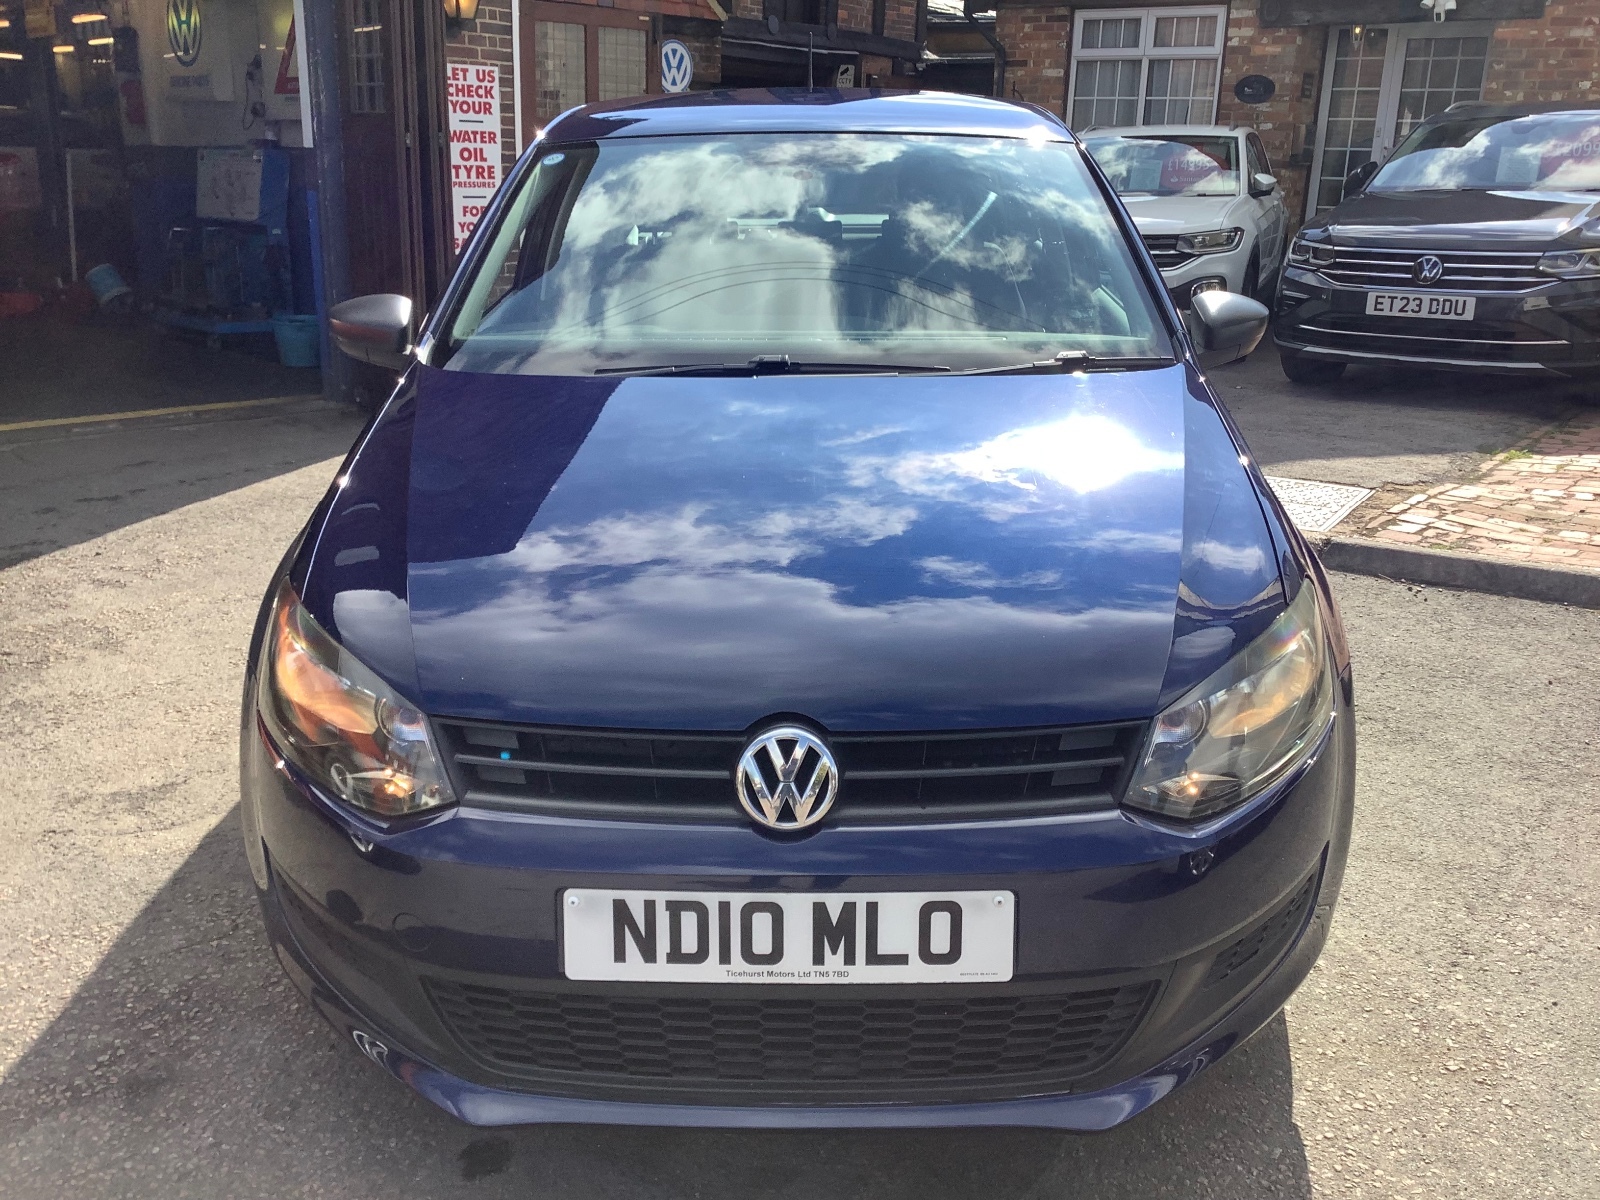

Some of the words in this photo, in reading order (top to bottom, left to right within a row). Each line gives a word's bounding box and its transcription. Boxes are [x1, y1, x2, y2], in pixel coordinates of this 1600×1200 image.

[475, 68, 496, 83] US
[447, 83, 495, 100] CHECK
[448, 99, 493, 115] YOUR
[449, 129, 497, 144] WATER
[459, 147, 488, 163] OIL
[452, 164, 496, 180] TYRE
[452, 180, 496, 188] PRESSURES
[1373, 295, 1423, 314] ET23
[1427, 298, 1467, 317] DDU
[736, 727, 838, 830] VW
[612, 898, 784, 966] ND10
[812, 900, 963, 967] MLO
[725, 969, 765, 978] Ticehurst
[766, 970, 795, 978] Motors
[797, 970, 811, 978] Ltd
[813, 970, 830, 978] TN5
[831, 970, 850, 978] 7BD
